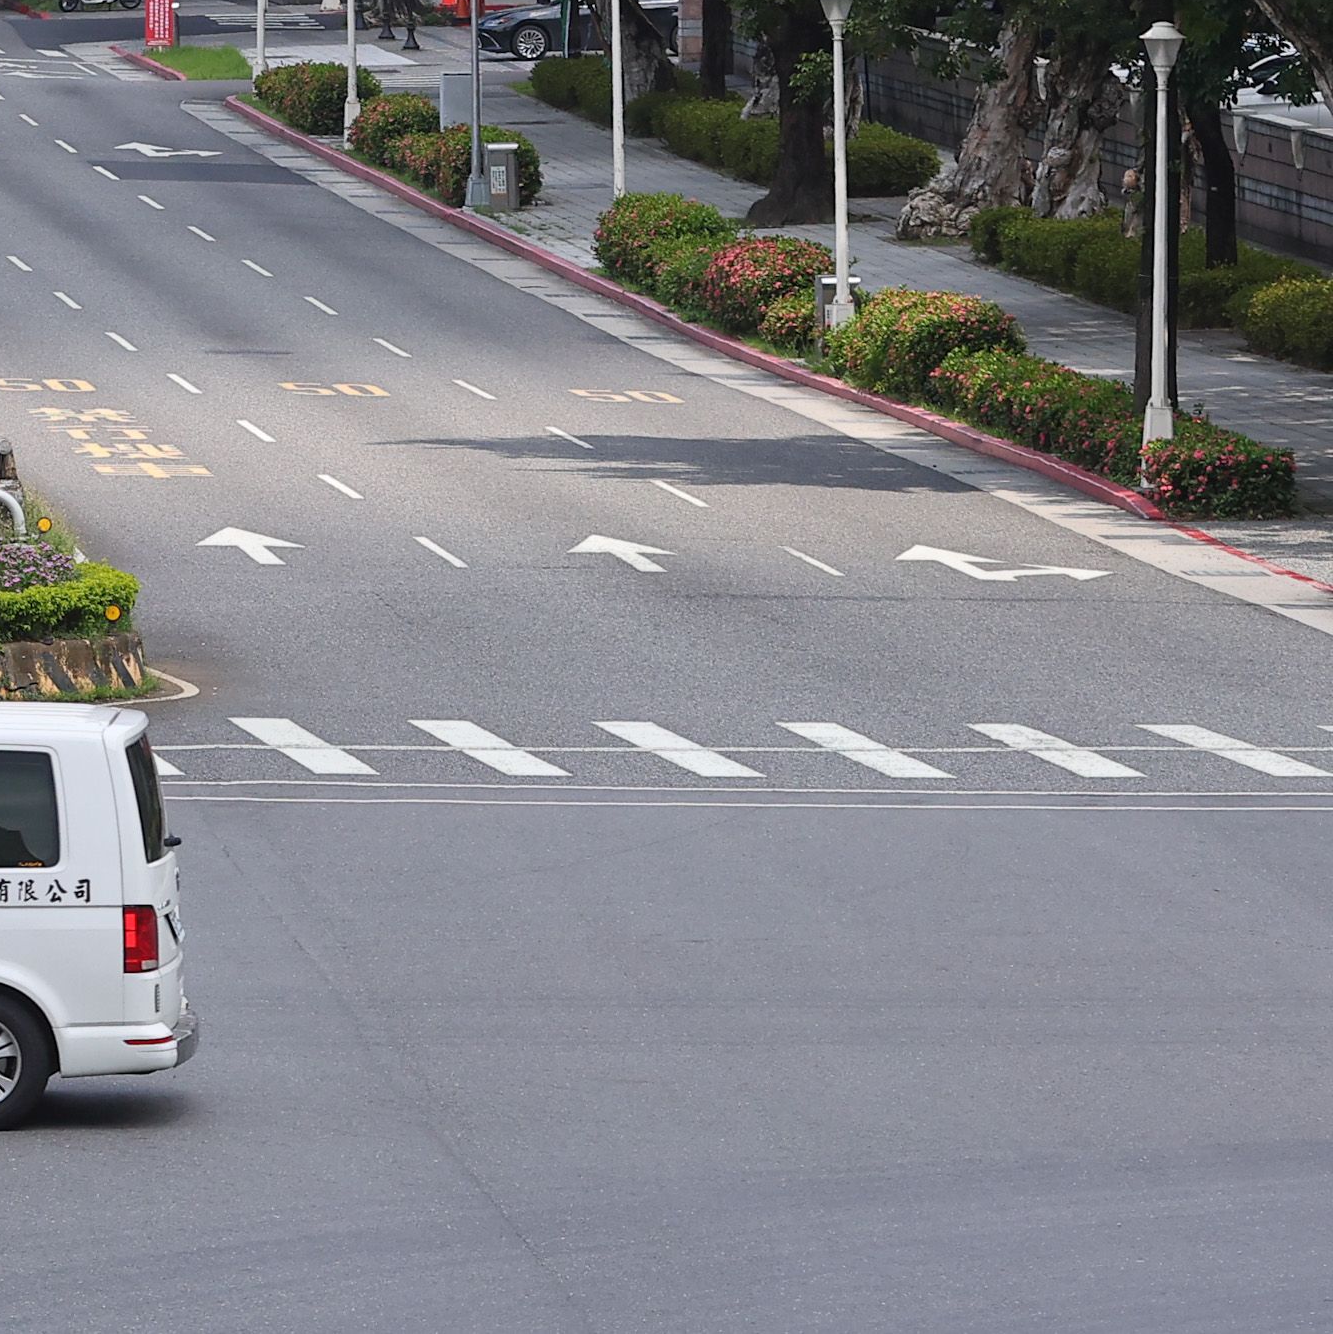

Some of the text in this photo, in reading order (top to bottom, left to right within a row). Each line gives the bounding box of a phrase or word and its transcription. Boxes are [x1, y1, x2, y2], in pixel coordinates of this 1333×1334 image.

[277, 381, 392, 397] 50
[567, 388, 686, 404] 50
[26, 407, 215, 479] 禁行機車
